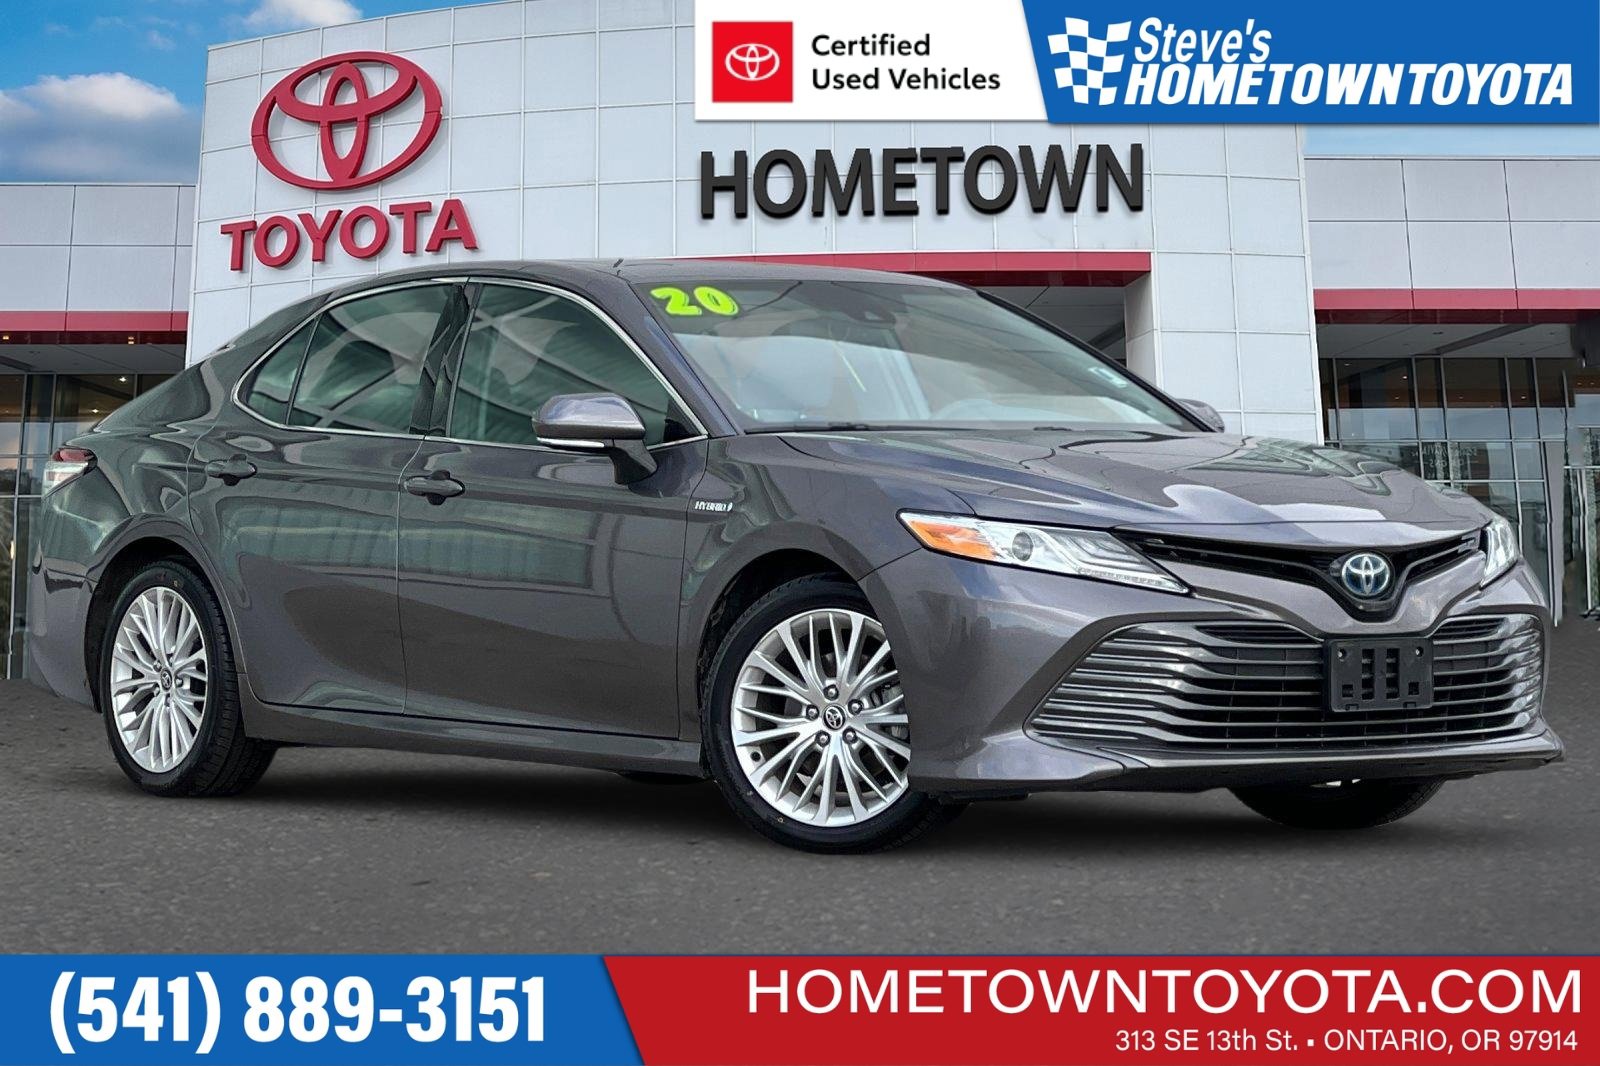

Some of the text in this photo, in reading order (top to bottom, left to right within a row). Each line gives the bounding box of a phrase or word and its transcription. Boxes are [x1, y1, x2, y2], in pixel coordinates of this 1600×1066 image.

[700, 143, 1144, 219] HOMETOWN
[221, 199, 477, 270] TOYOTA
[650, 286, 739, 316] 20
